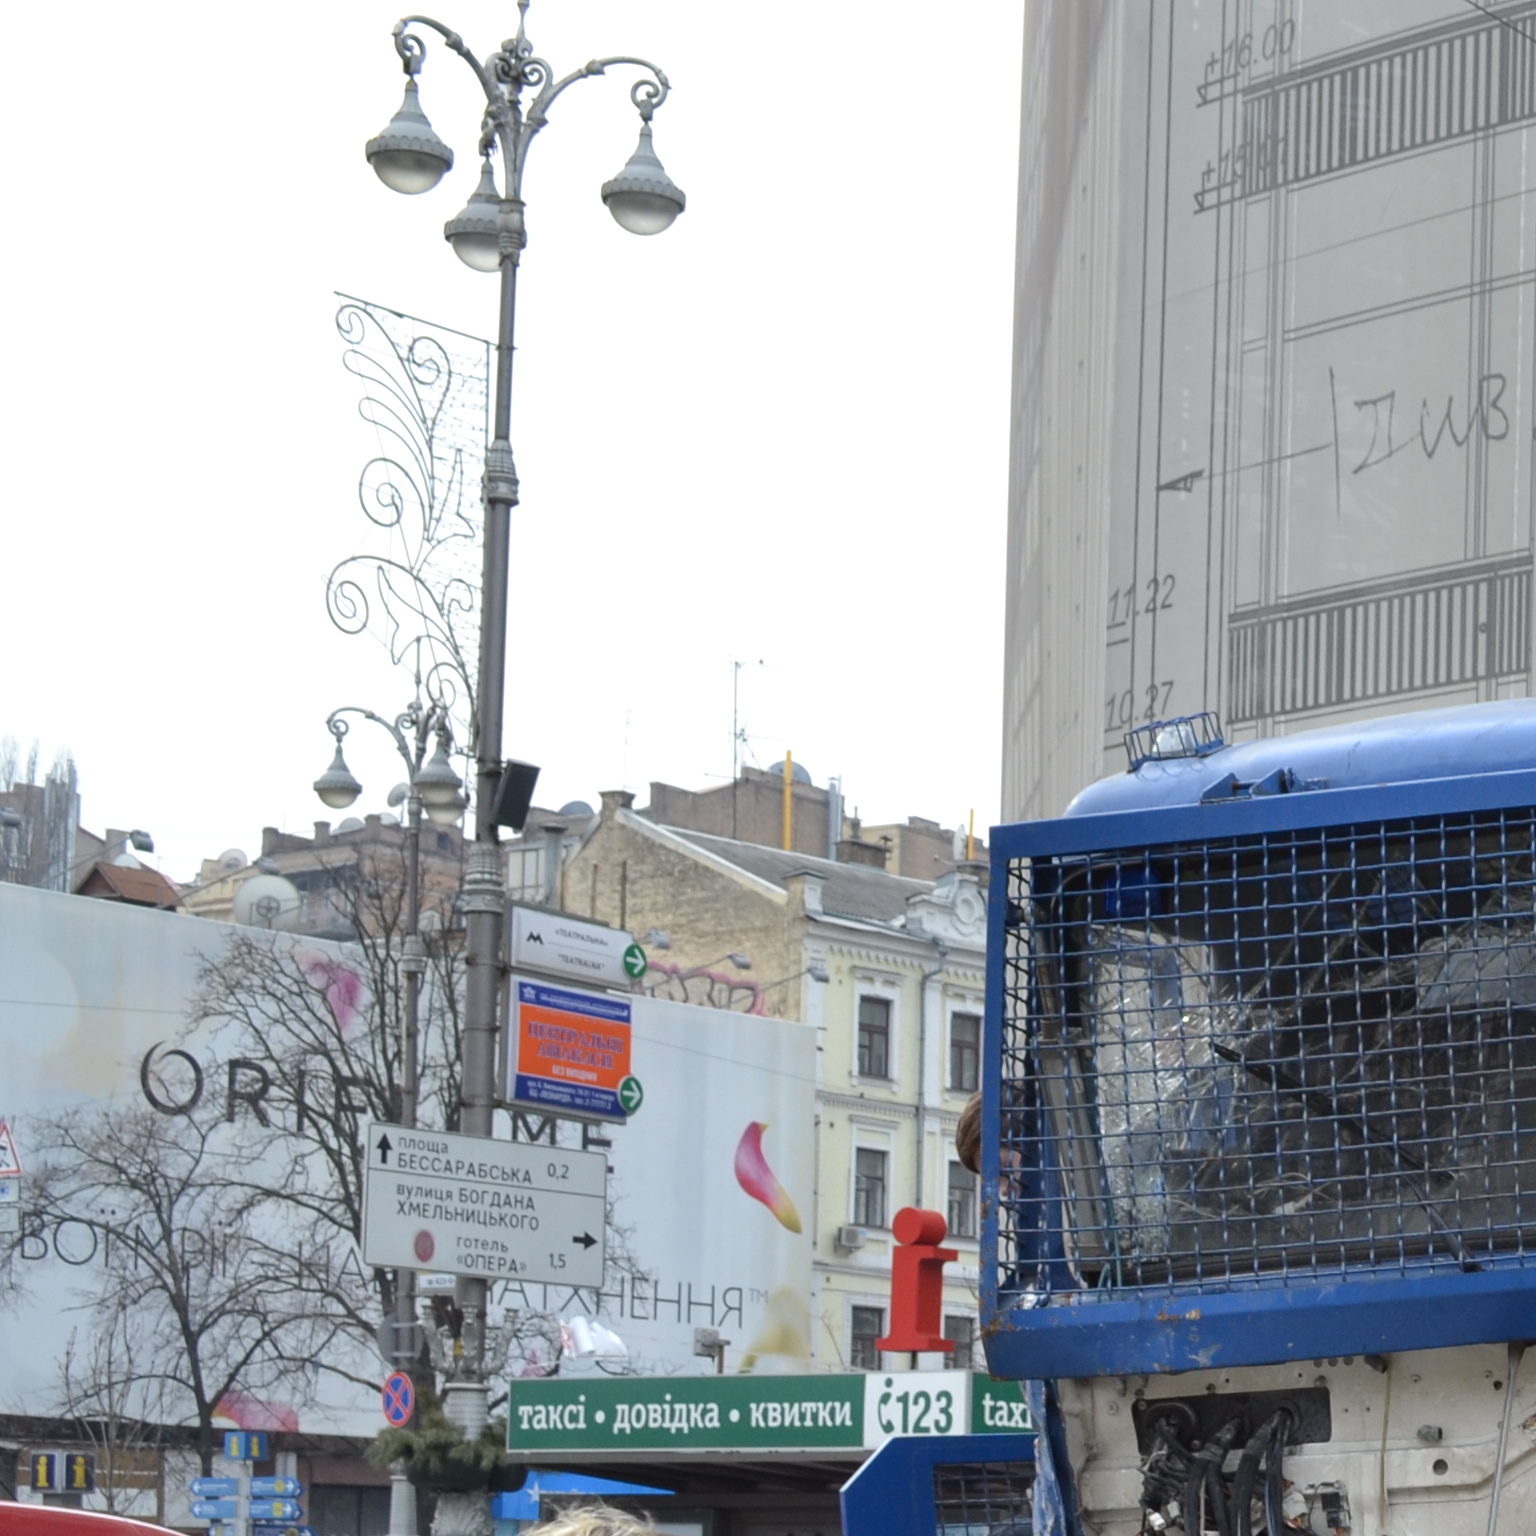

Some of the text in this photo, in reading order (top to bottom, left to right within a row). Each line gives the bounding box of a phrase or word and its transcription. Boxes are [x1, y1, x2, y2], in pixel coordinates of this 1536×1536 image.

[398, 1137, 449, 1155] площа
[398, 1152, 570, 1185] БЕССАРАБСЬКА 0,2
[397, 1183, 536, 1211] вулиця БОГДАНА
[397, 1200, 540, 1231] ХМЕЛЬНИЦЬКОГО
[456, 1235, 509, 1253] готель
[456, 1252, 567, 1274] «ОПЕРА» 1,5
[518, 1392, 854, 1434] таксі довідка квитки
